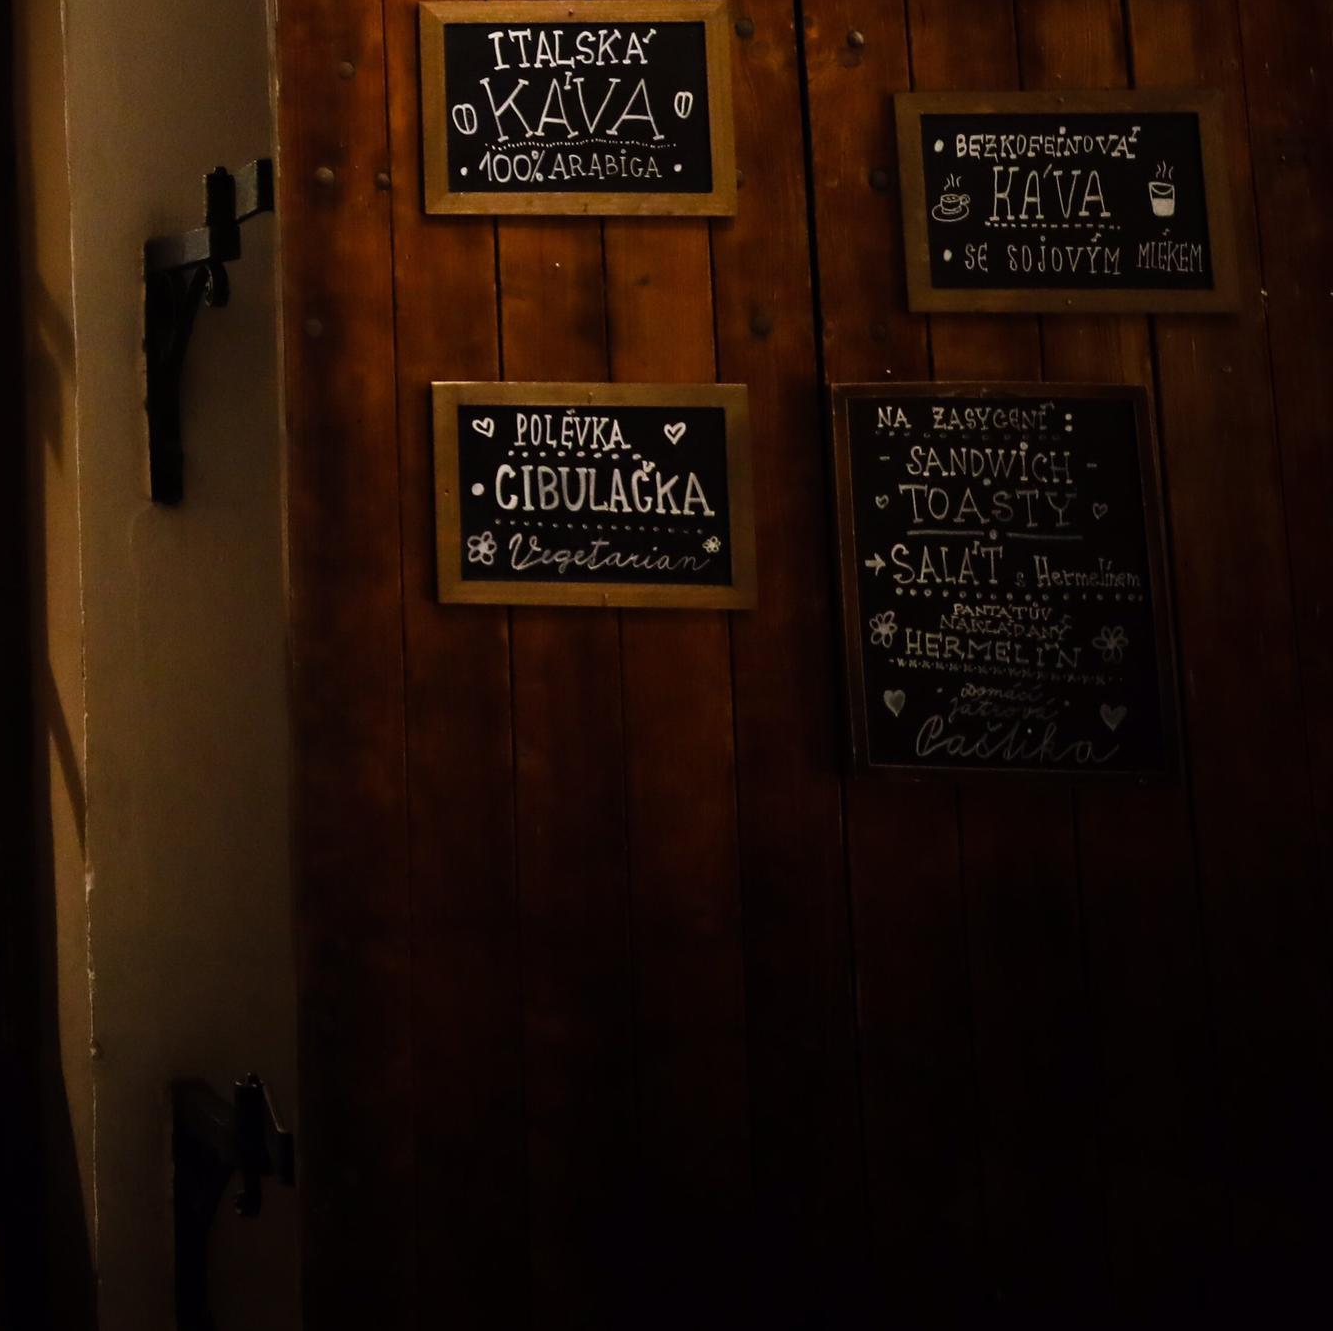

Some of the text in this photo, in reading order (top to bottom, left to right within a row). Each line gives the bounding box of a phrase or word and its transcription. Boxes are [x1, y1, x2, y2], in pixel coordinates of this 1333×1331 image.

[488, 28, 657, 70] ITALSKÁ
[480, 72, 665, 143] KÁVA
[479, 149, 545, 183] 100%
[988, 163, 1112, 222] KÁVA
[965, 228, 1203, 275] SE SOJOVÝM MLÉKEM
[514, 408, 631, 451] POLÉVKA
[877, 406, 912, 429] NA
[495, 460, 715, 517] CIBULAČKA
[899, 483, 1077, 528] TOASTY
[891, 540, 1003, 584] SALÁT
[904, 627, 1082, 669] HERMELÍN
